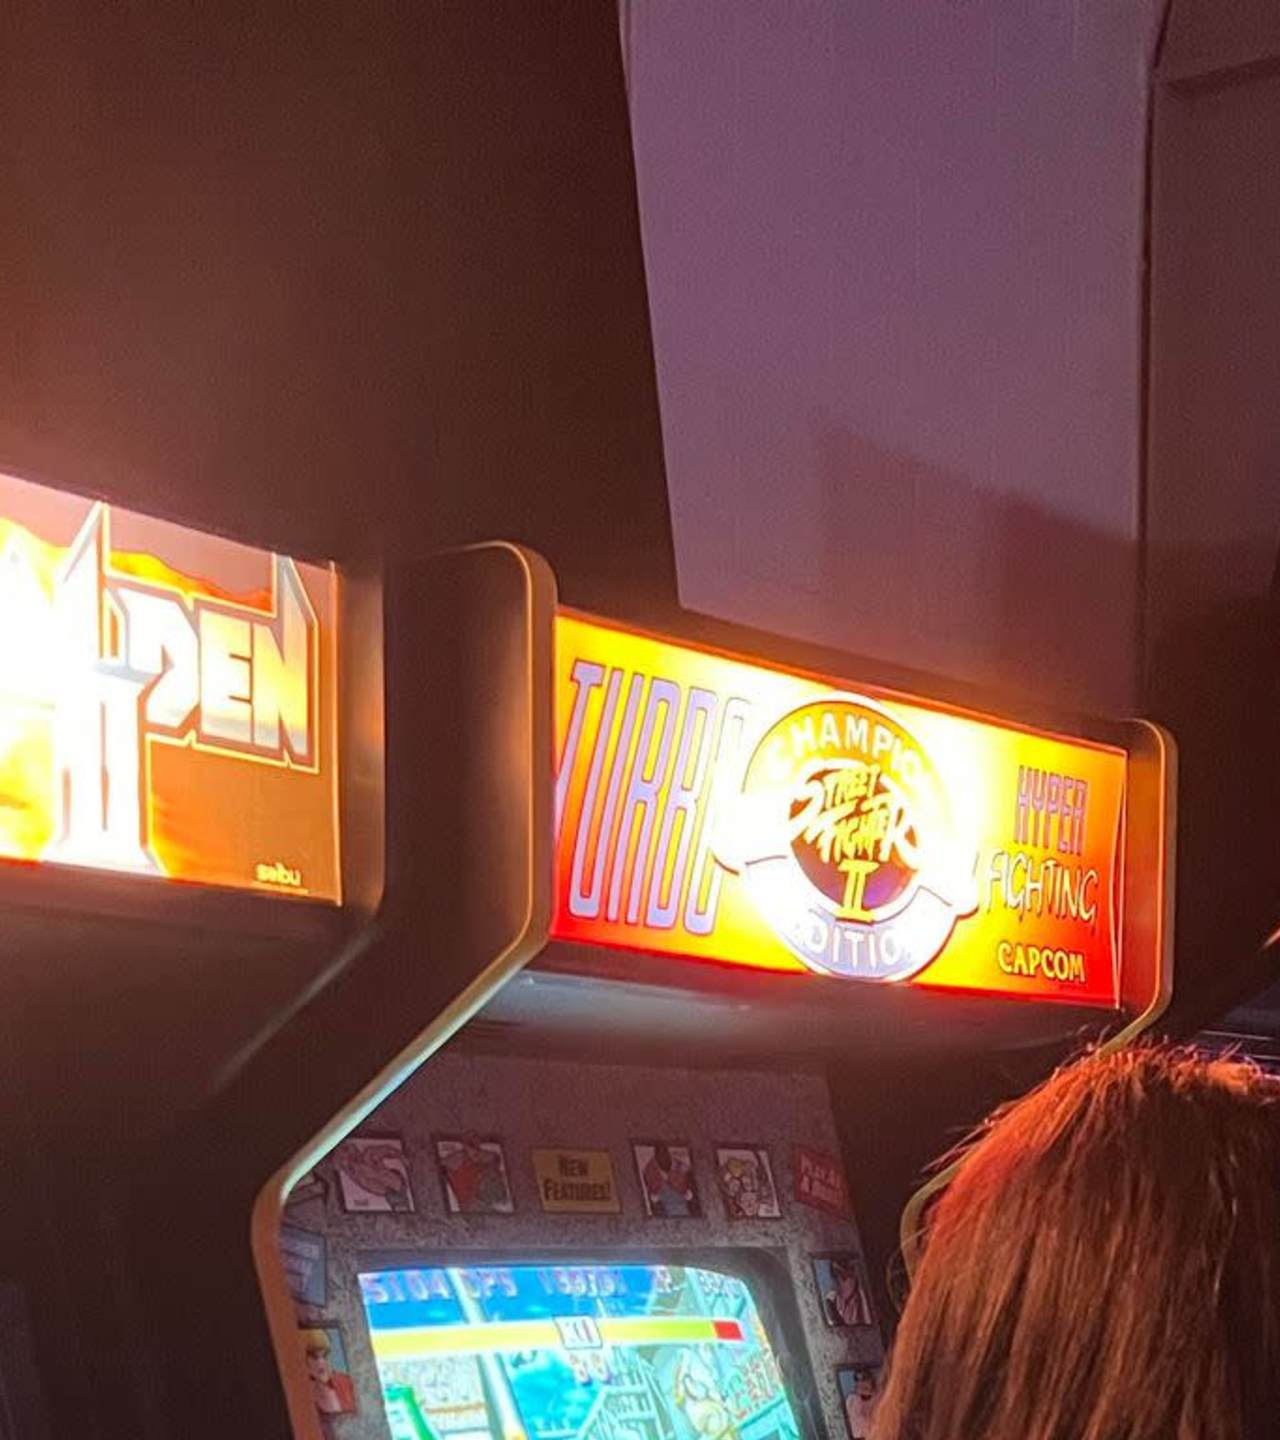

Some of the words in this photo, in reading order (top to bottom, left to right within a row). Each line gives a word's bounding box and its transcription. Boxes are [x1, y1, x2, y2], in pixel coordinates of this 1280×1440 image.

[770, 711, 928, 780] CHAMPIO
[556, 658, 752, 936] TURBO
[1014, 766, 1091, 857] HYPER
[982, 849, 1099, 936] FIGHTING
[792, 920, 910, 970] DITIO
[997, 940, 1086, 984] CAPCOM
